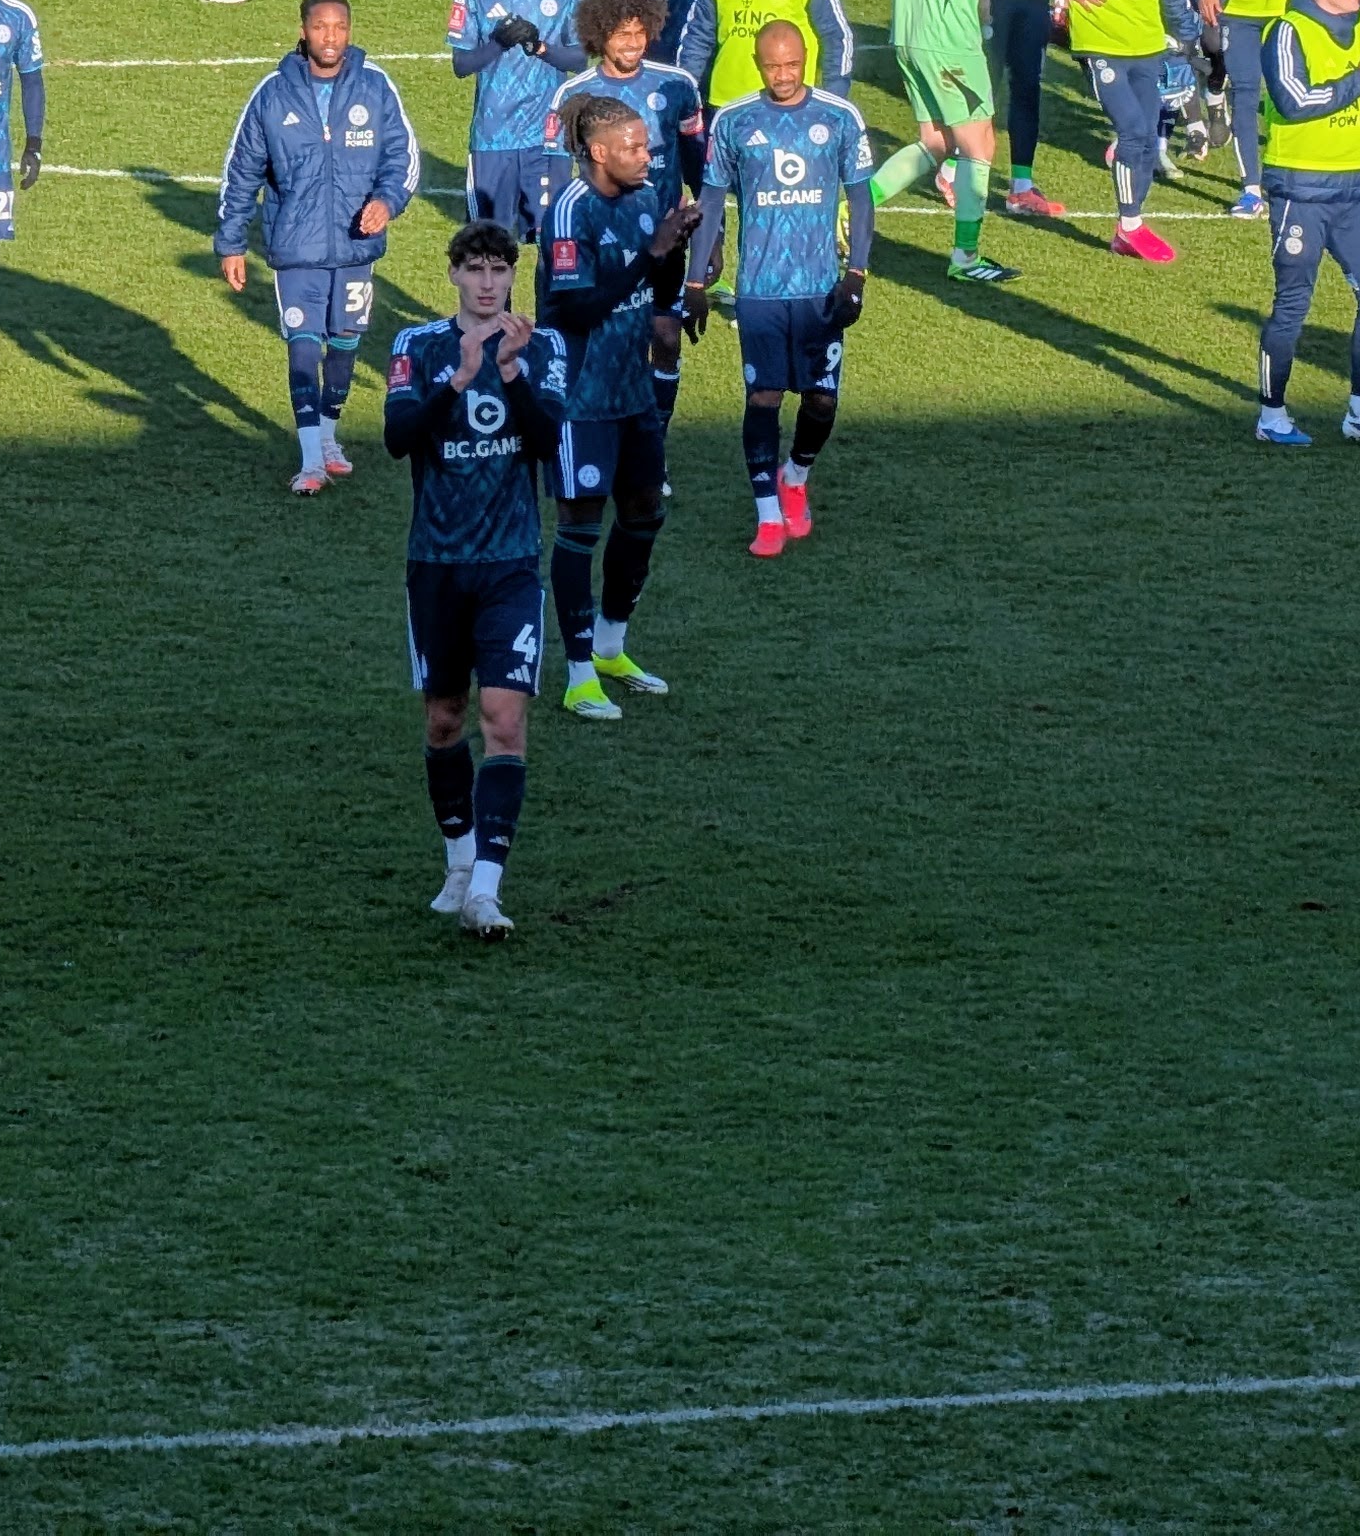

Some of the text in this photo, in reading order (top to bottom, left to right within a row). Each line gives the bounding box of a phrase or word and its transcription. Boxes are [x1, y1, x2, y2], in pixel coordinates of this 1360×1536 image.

[344, 130, 375, 140] KING
[756, 189, 823, 206] BC.GAME
[825, 341, 843, 372] 9
[511, 623, 538, 664] 4
